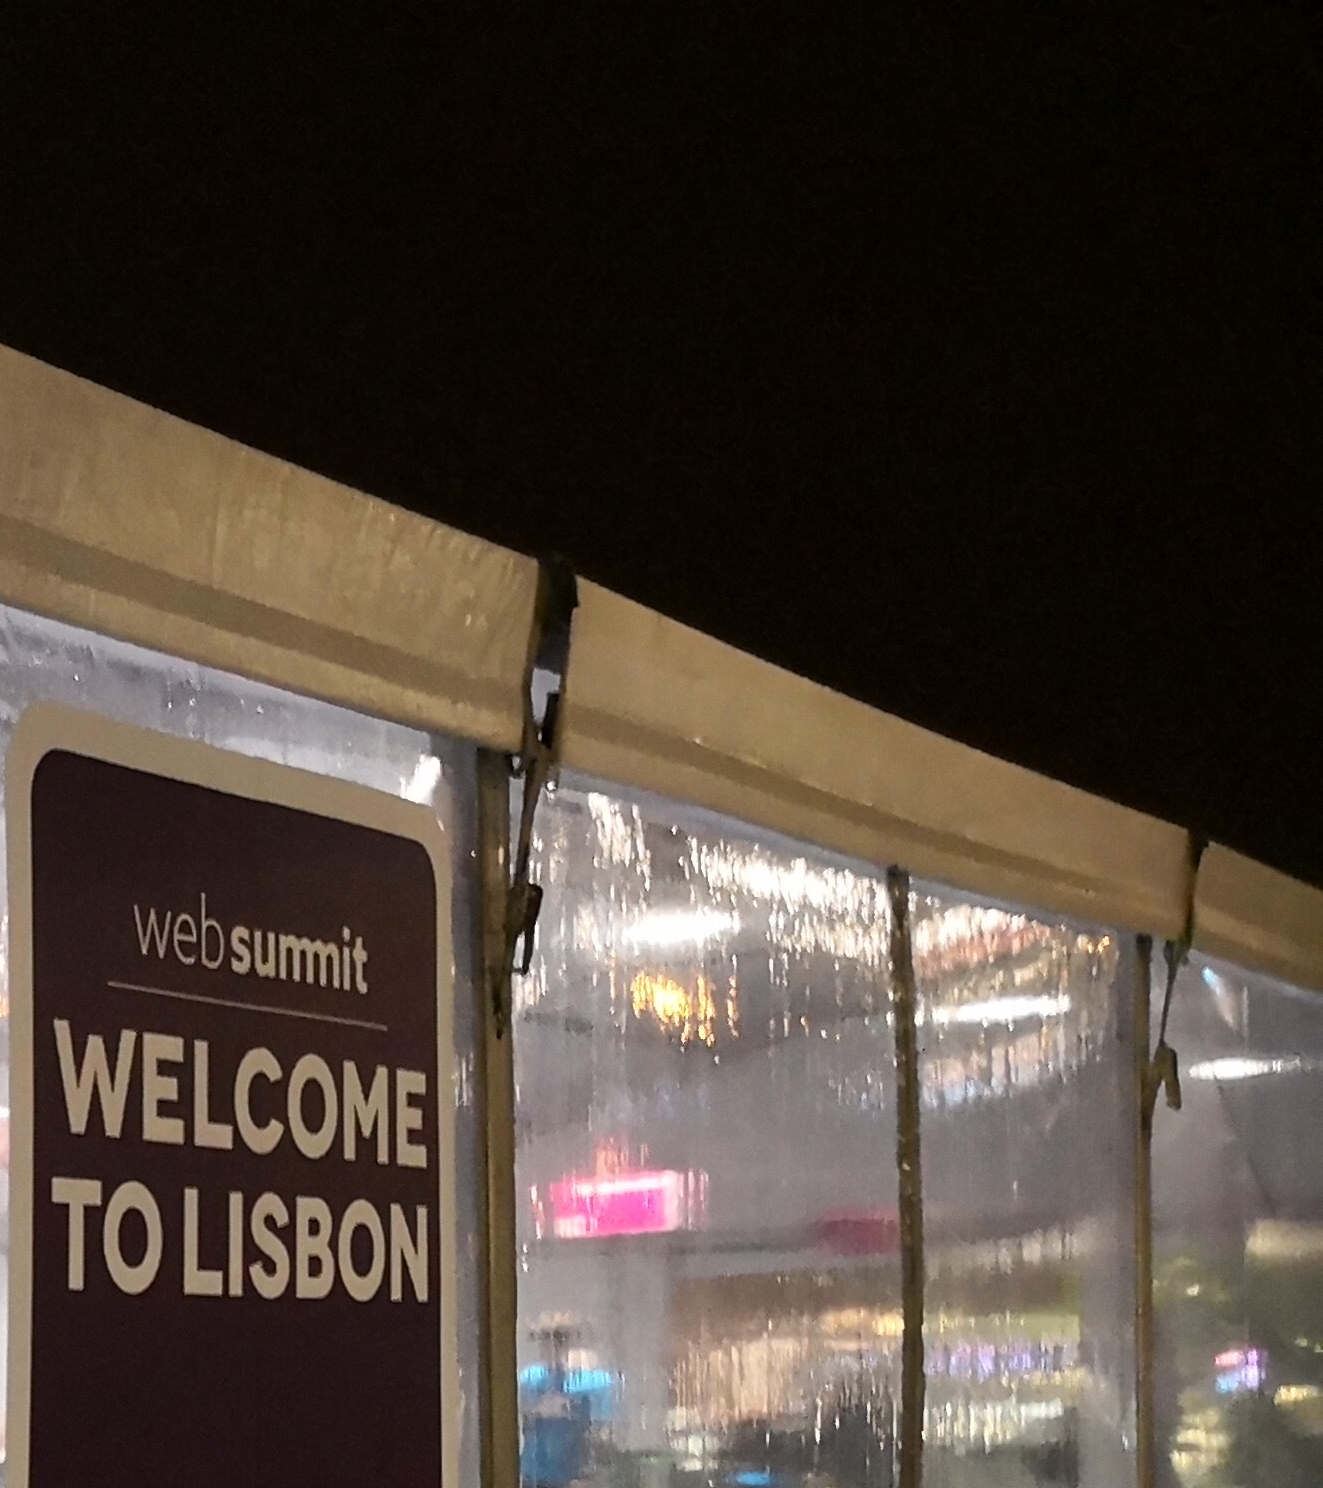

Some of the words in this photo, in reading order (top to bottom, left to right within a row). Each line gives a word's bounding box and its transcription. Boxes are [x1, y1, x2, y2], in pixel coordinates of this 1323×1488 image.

[53, 1017, 428, 1169] WELCOME
[51, 1176, 163, 1296] TO
[183, 1186, 429, 1304] LISBON
